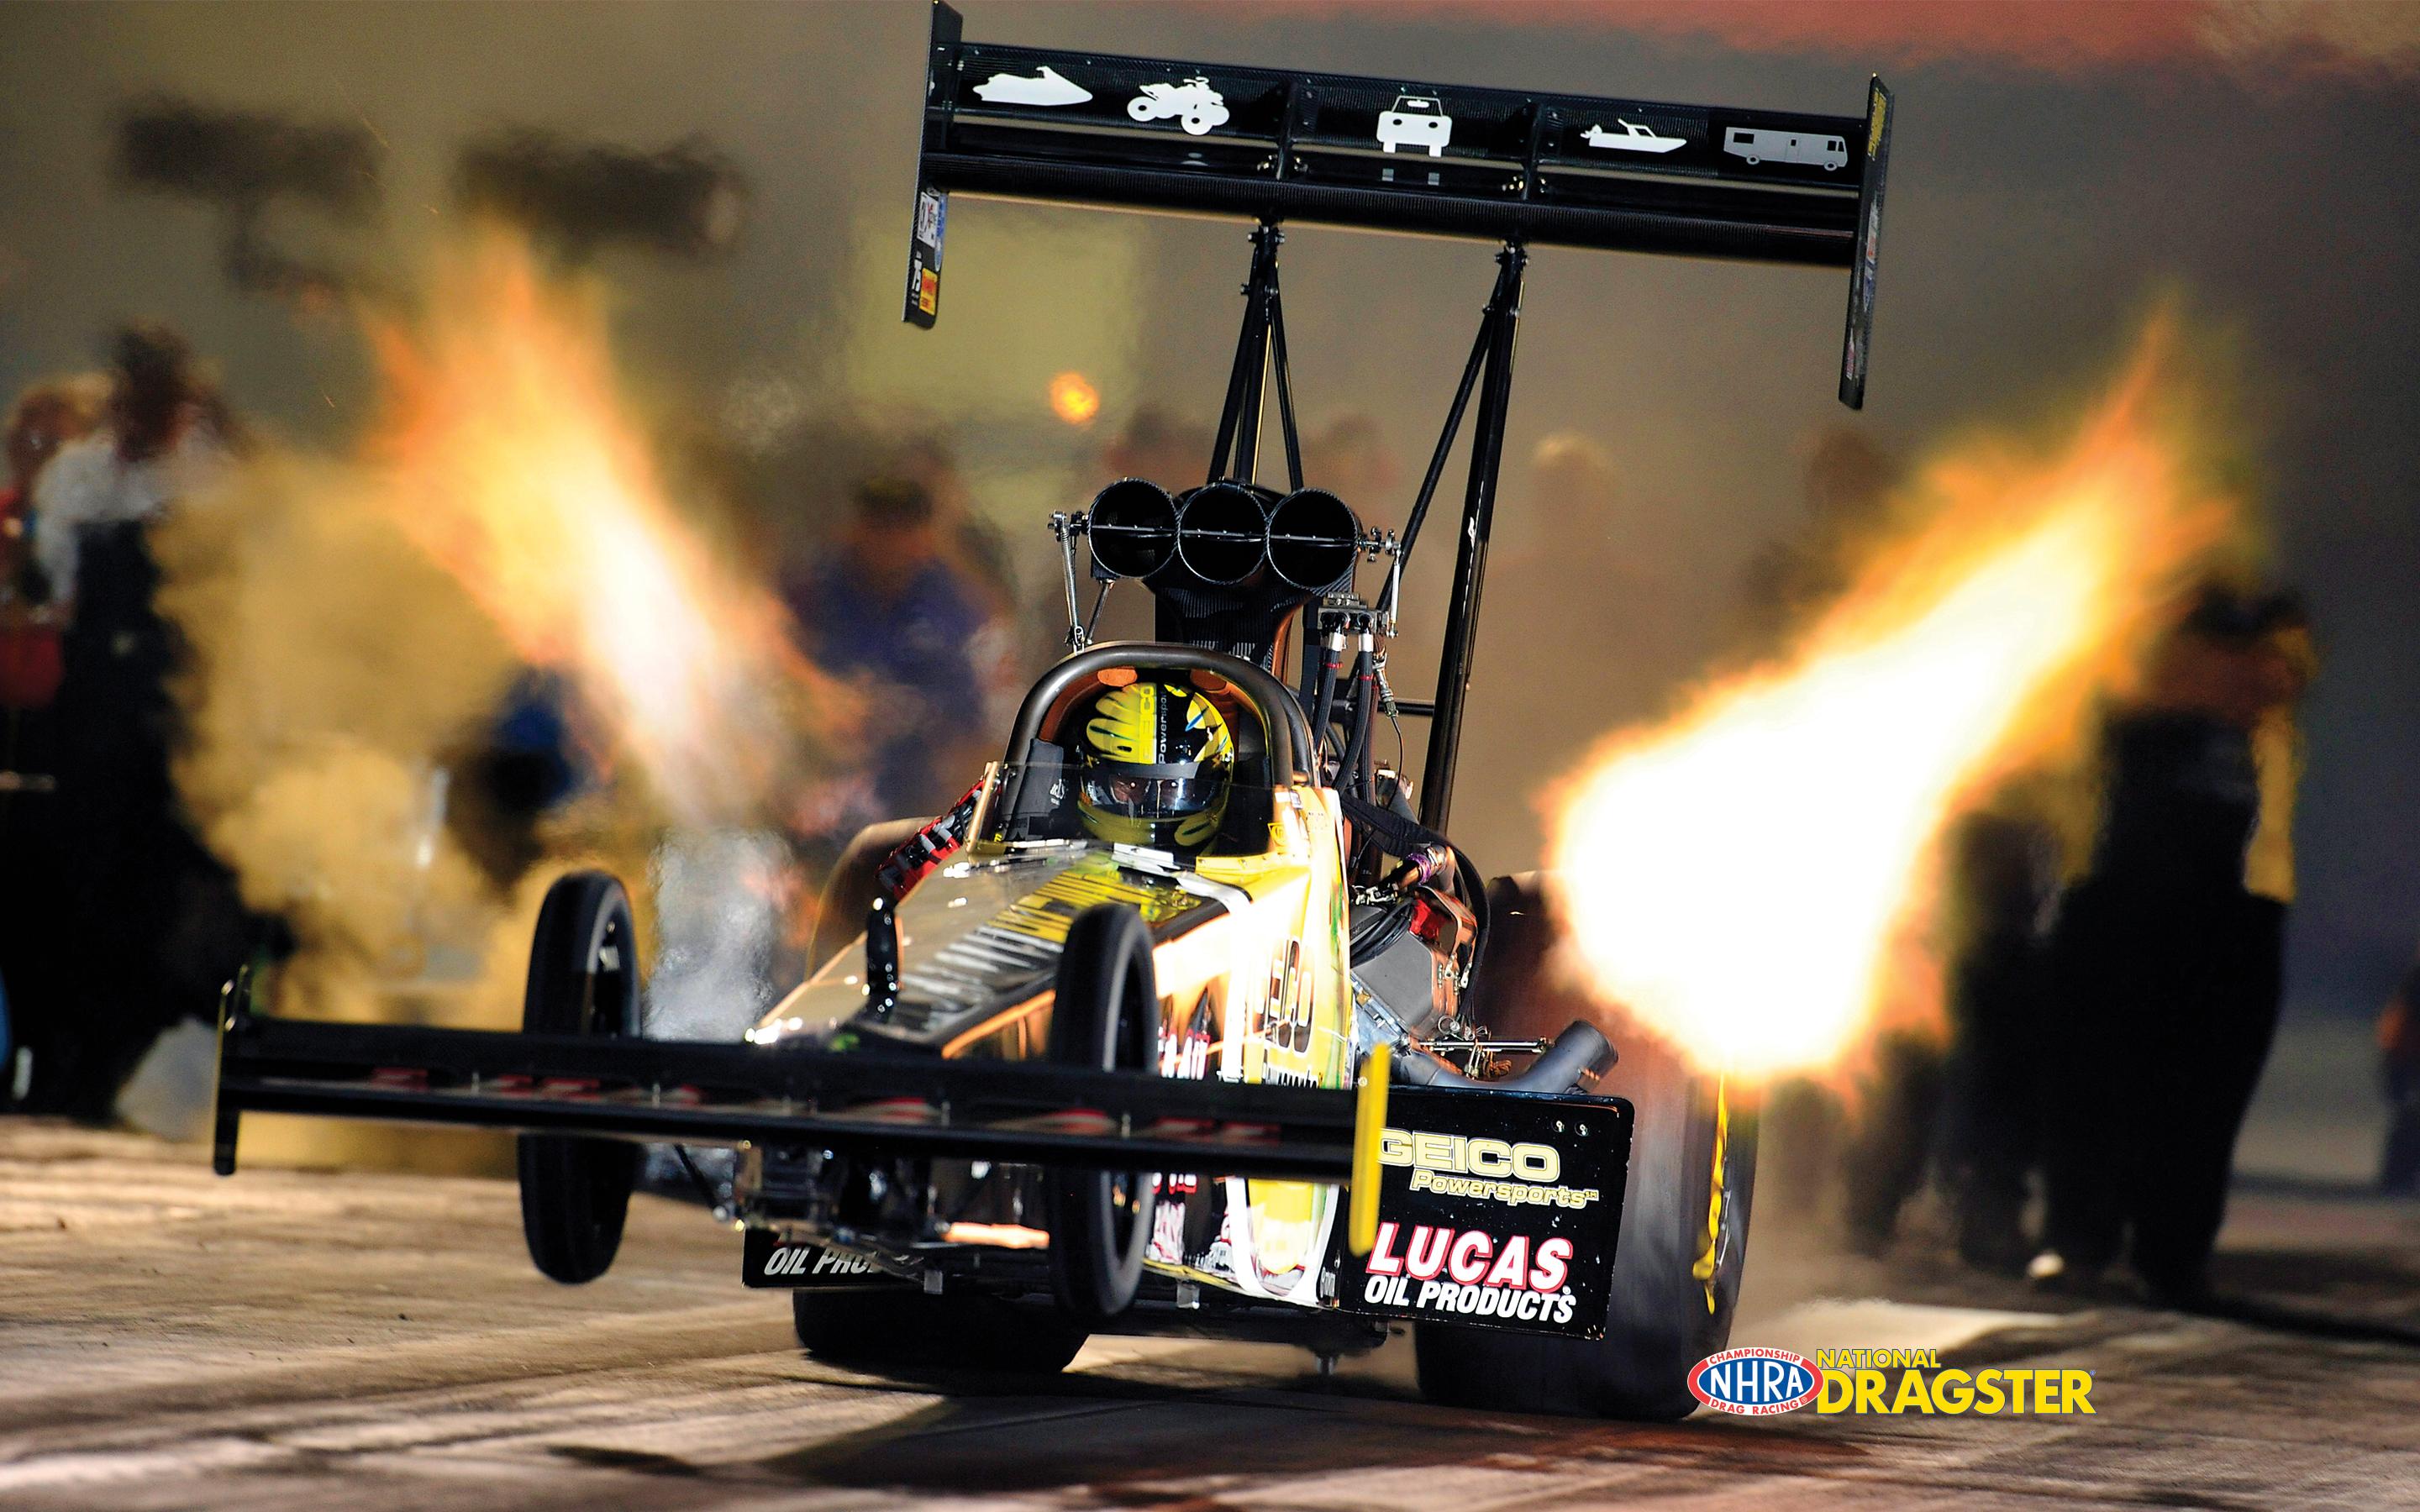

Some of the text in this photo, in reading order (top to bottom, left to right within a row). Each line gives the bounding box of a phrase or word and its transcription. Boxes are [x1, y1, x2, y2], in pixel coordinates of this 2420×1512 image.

[1377, 1128, 1560, 1183] GEICO
[764, 1247, 811, 1275] OIL
[1365, 1222, 1574, 1294] LUCAS
[1364, 1274, 1410, 1307] OIL
[1416, 1282, 1576, 1324] PRODUCTS
